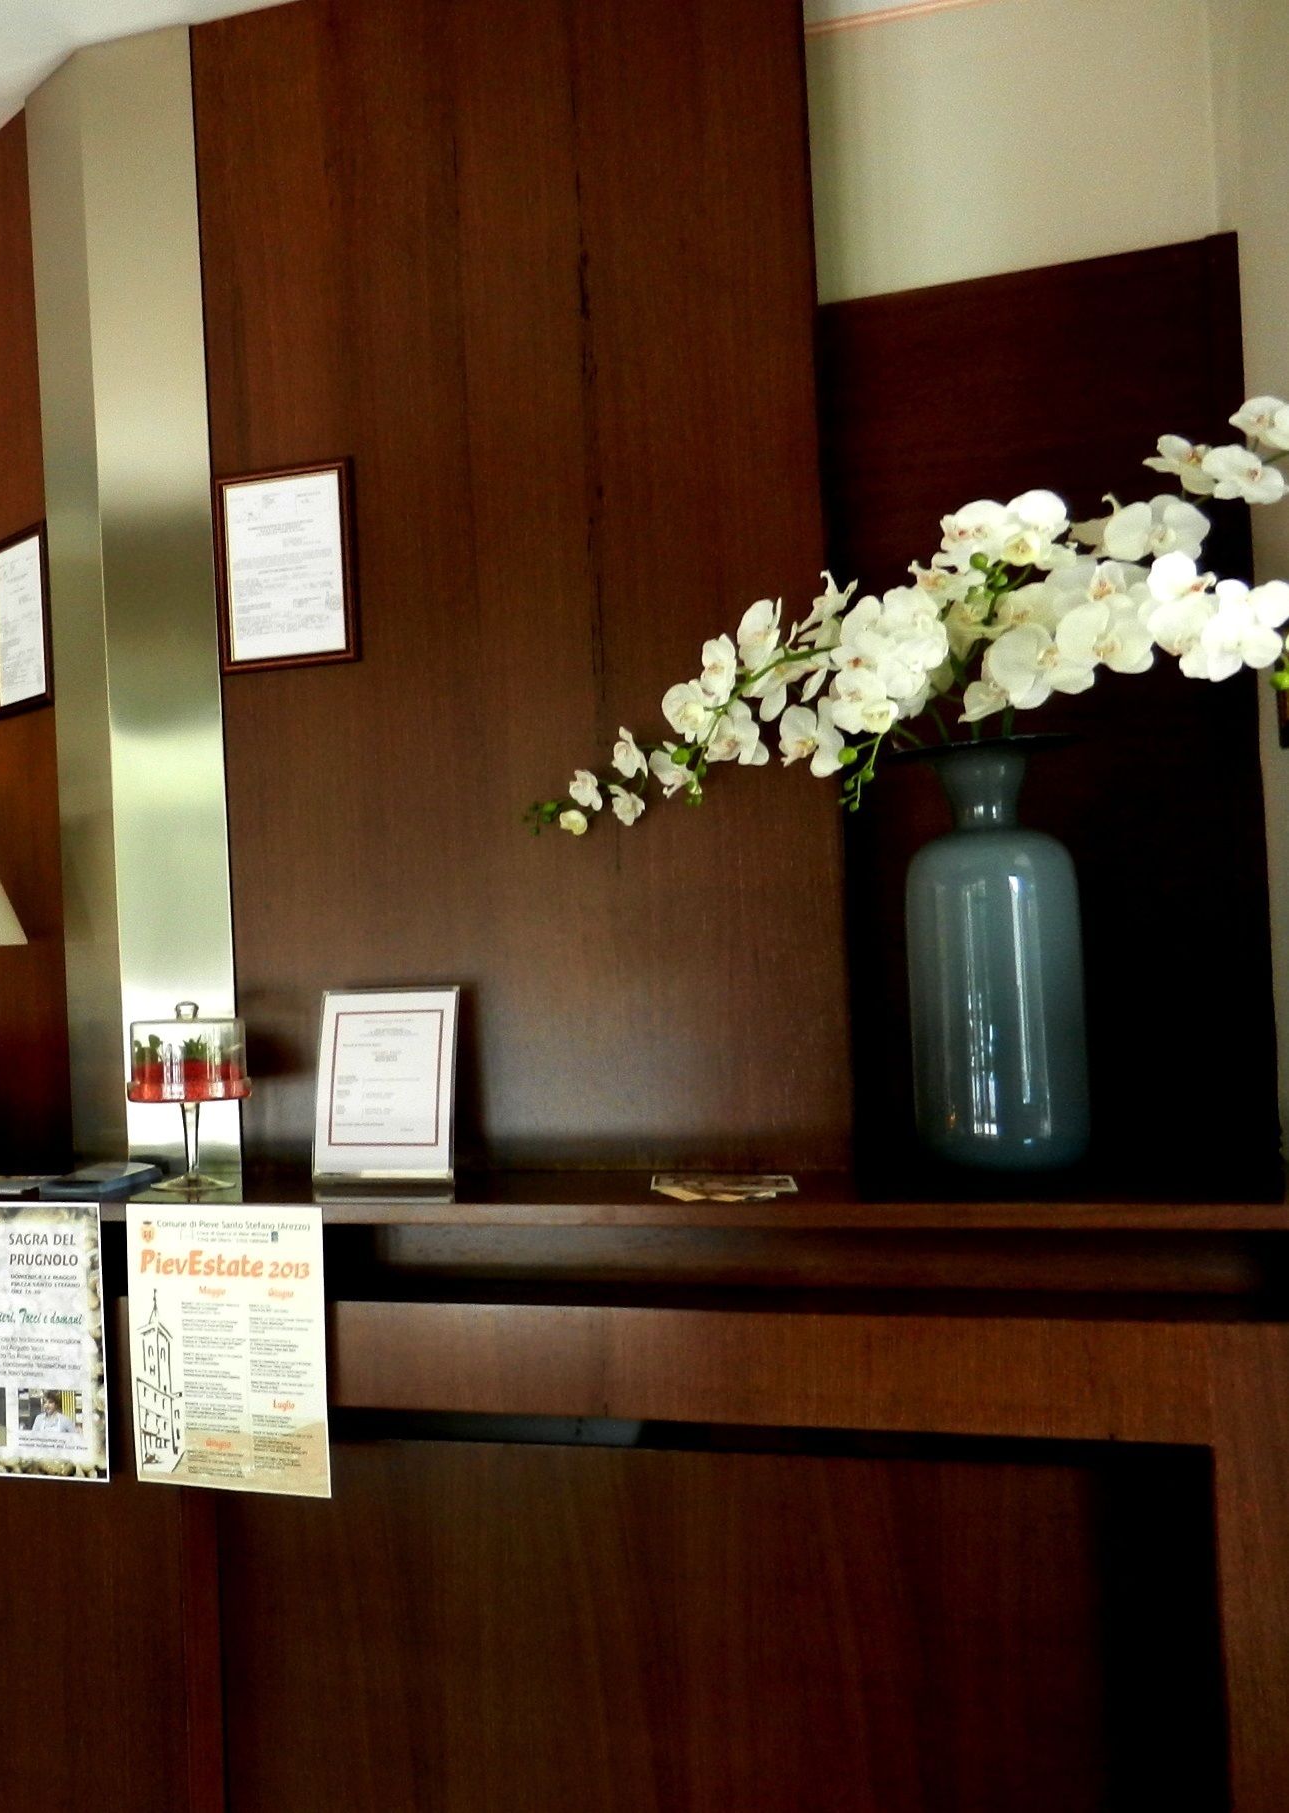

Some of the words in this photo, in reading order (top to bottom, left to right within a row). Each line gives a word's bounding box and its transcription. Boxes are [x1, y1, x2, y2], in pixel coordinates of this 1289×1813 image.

[157, 1220, 187, 1229] Comune
[189, 1220, 197, 1229] di
[199, 1221, 219, 1229] Pieve
[221, 1221, 243, 1230] Santo
[245, 1221, 275, 1231] Stefano
[277, 1222, 311, 1232] (Arezzo)
[9, 1233, 48, 1246] SAGRA
[53, 1234, 76, 1246] DEL
[9, 1253, 79, 1267] PRUGNOLO
[140, 1250, 264, 1278] PievEstate
[268, 1262, 311, 1280] 2013
[43, 1314, 48, 1324] e
[50, 1311, 83, 1325] domani
[272, 1399, 296, 1412] Luglio
